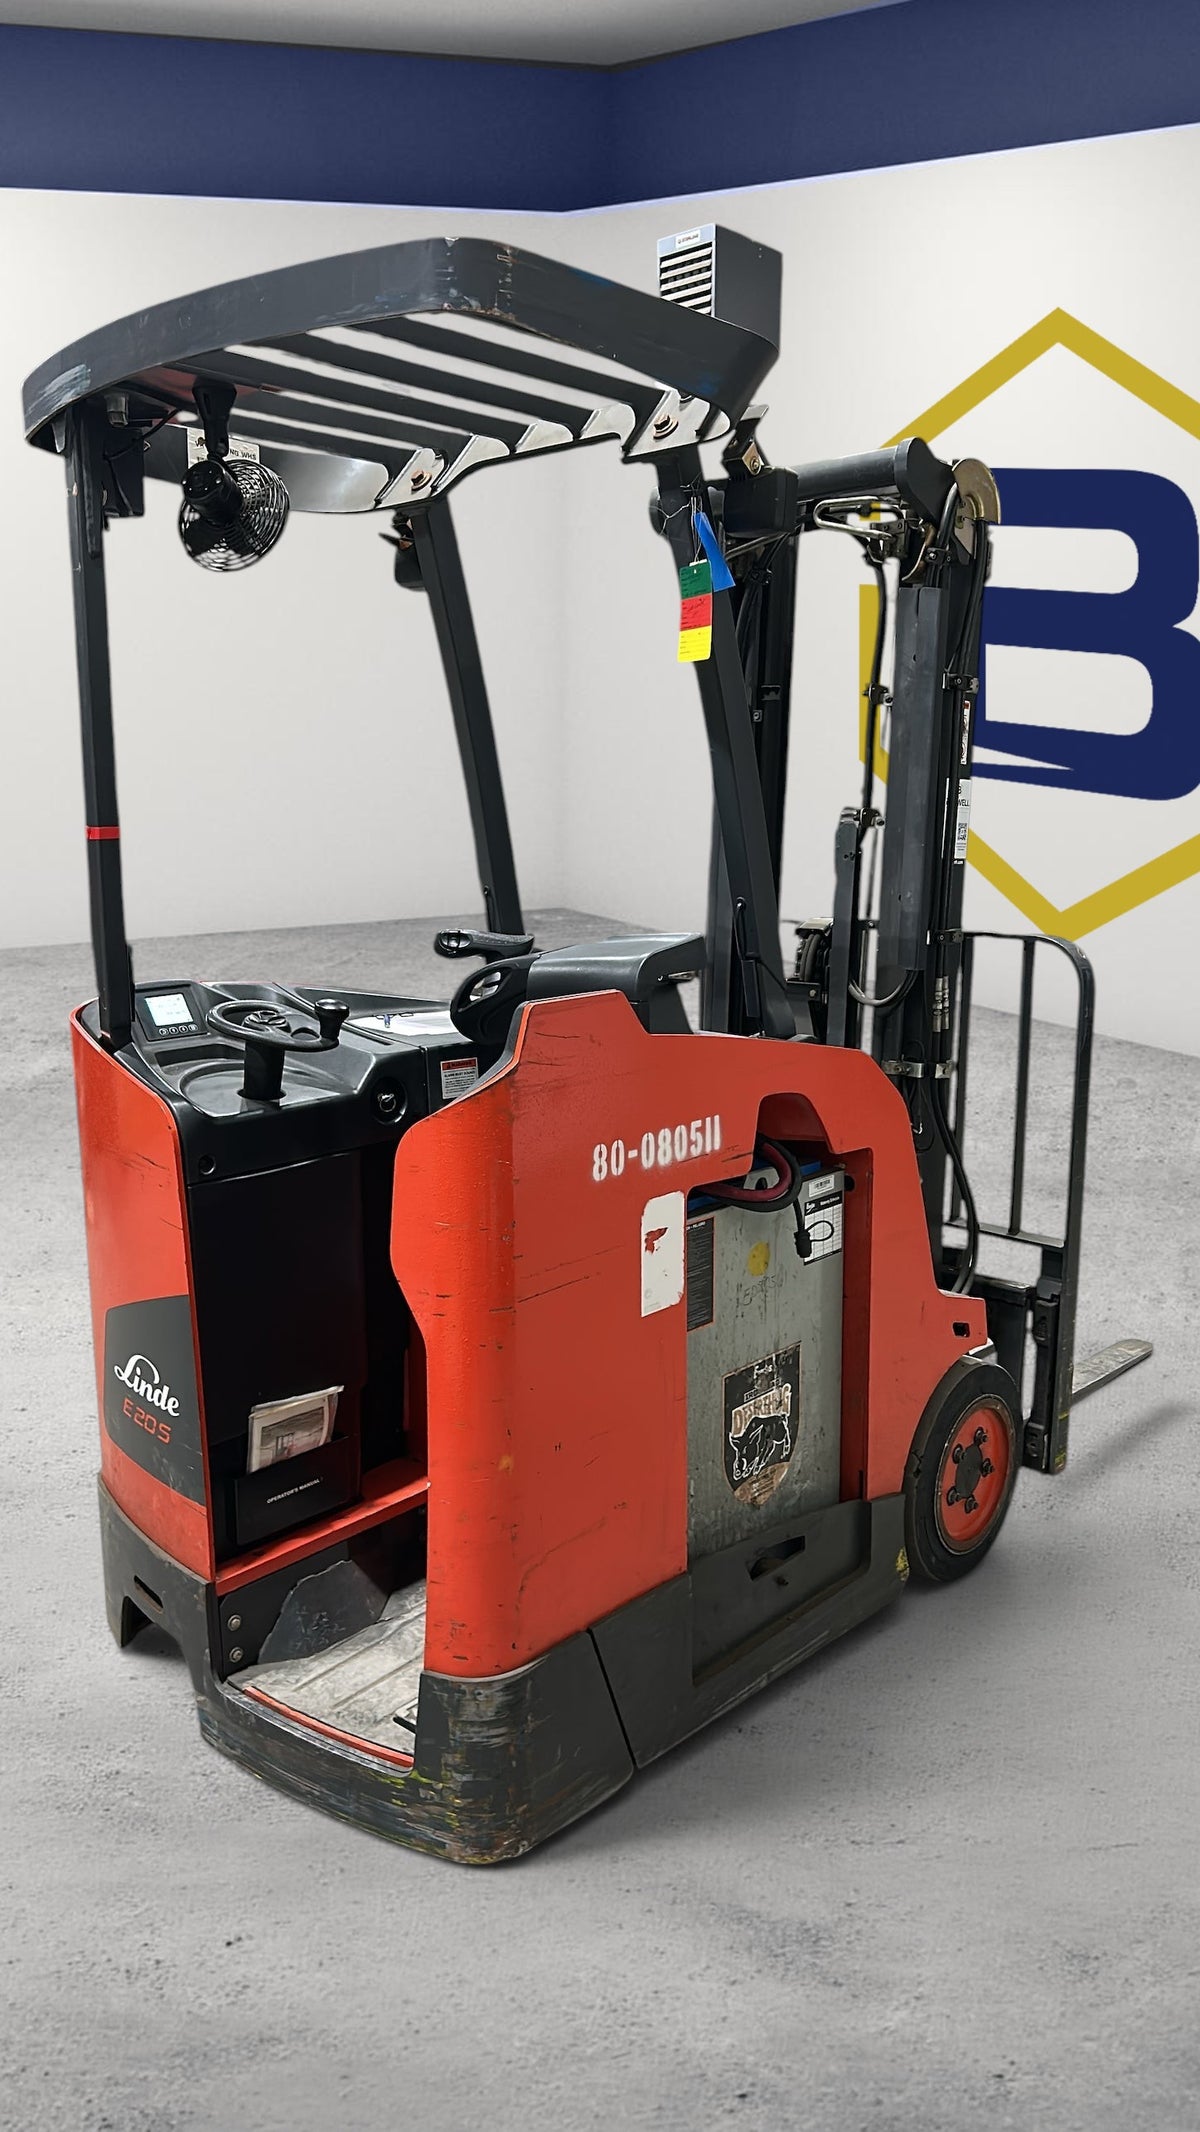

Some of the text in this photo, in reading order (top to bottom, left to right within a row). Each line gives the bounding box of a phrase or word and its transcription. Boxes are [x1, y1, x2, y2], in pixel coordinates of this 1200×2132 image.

[114, 1353, 180, 1417] Linde
[266, 1479, 320, 1504] OPERATOR'S MANUAL
